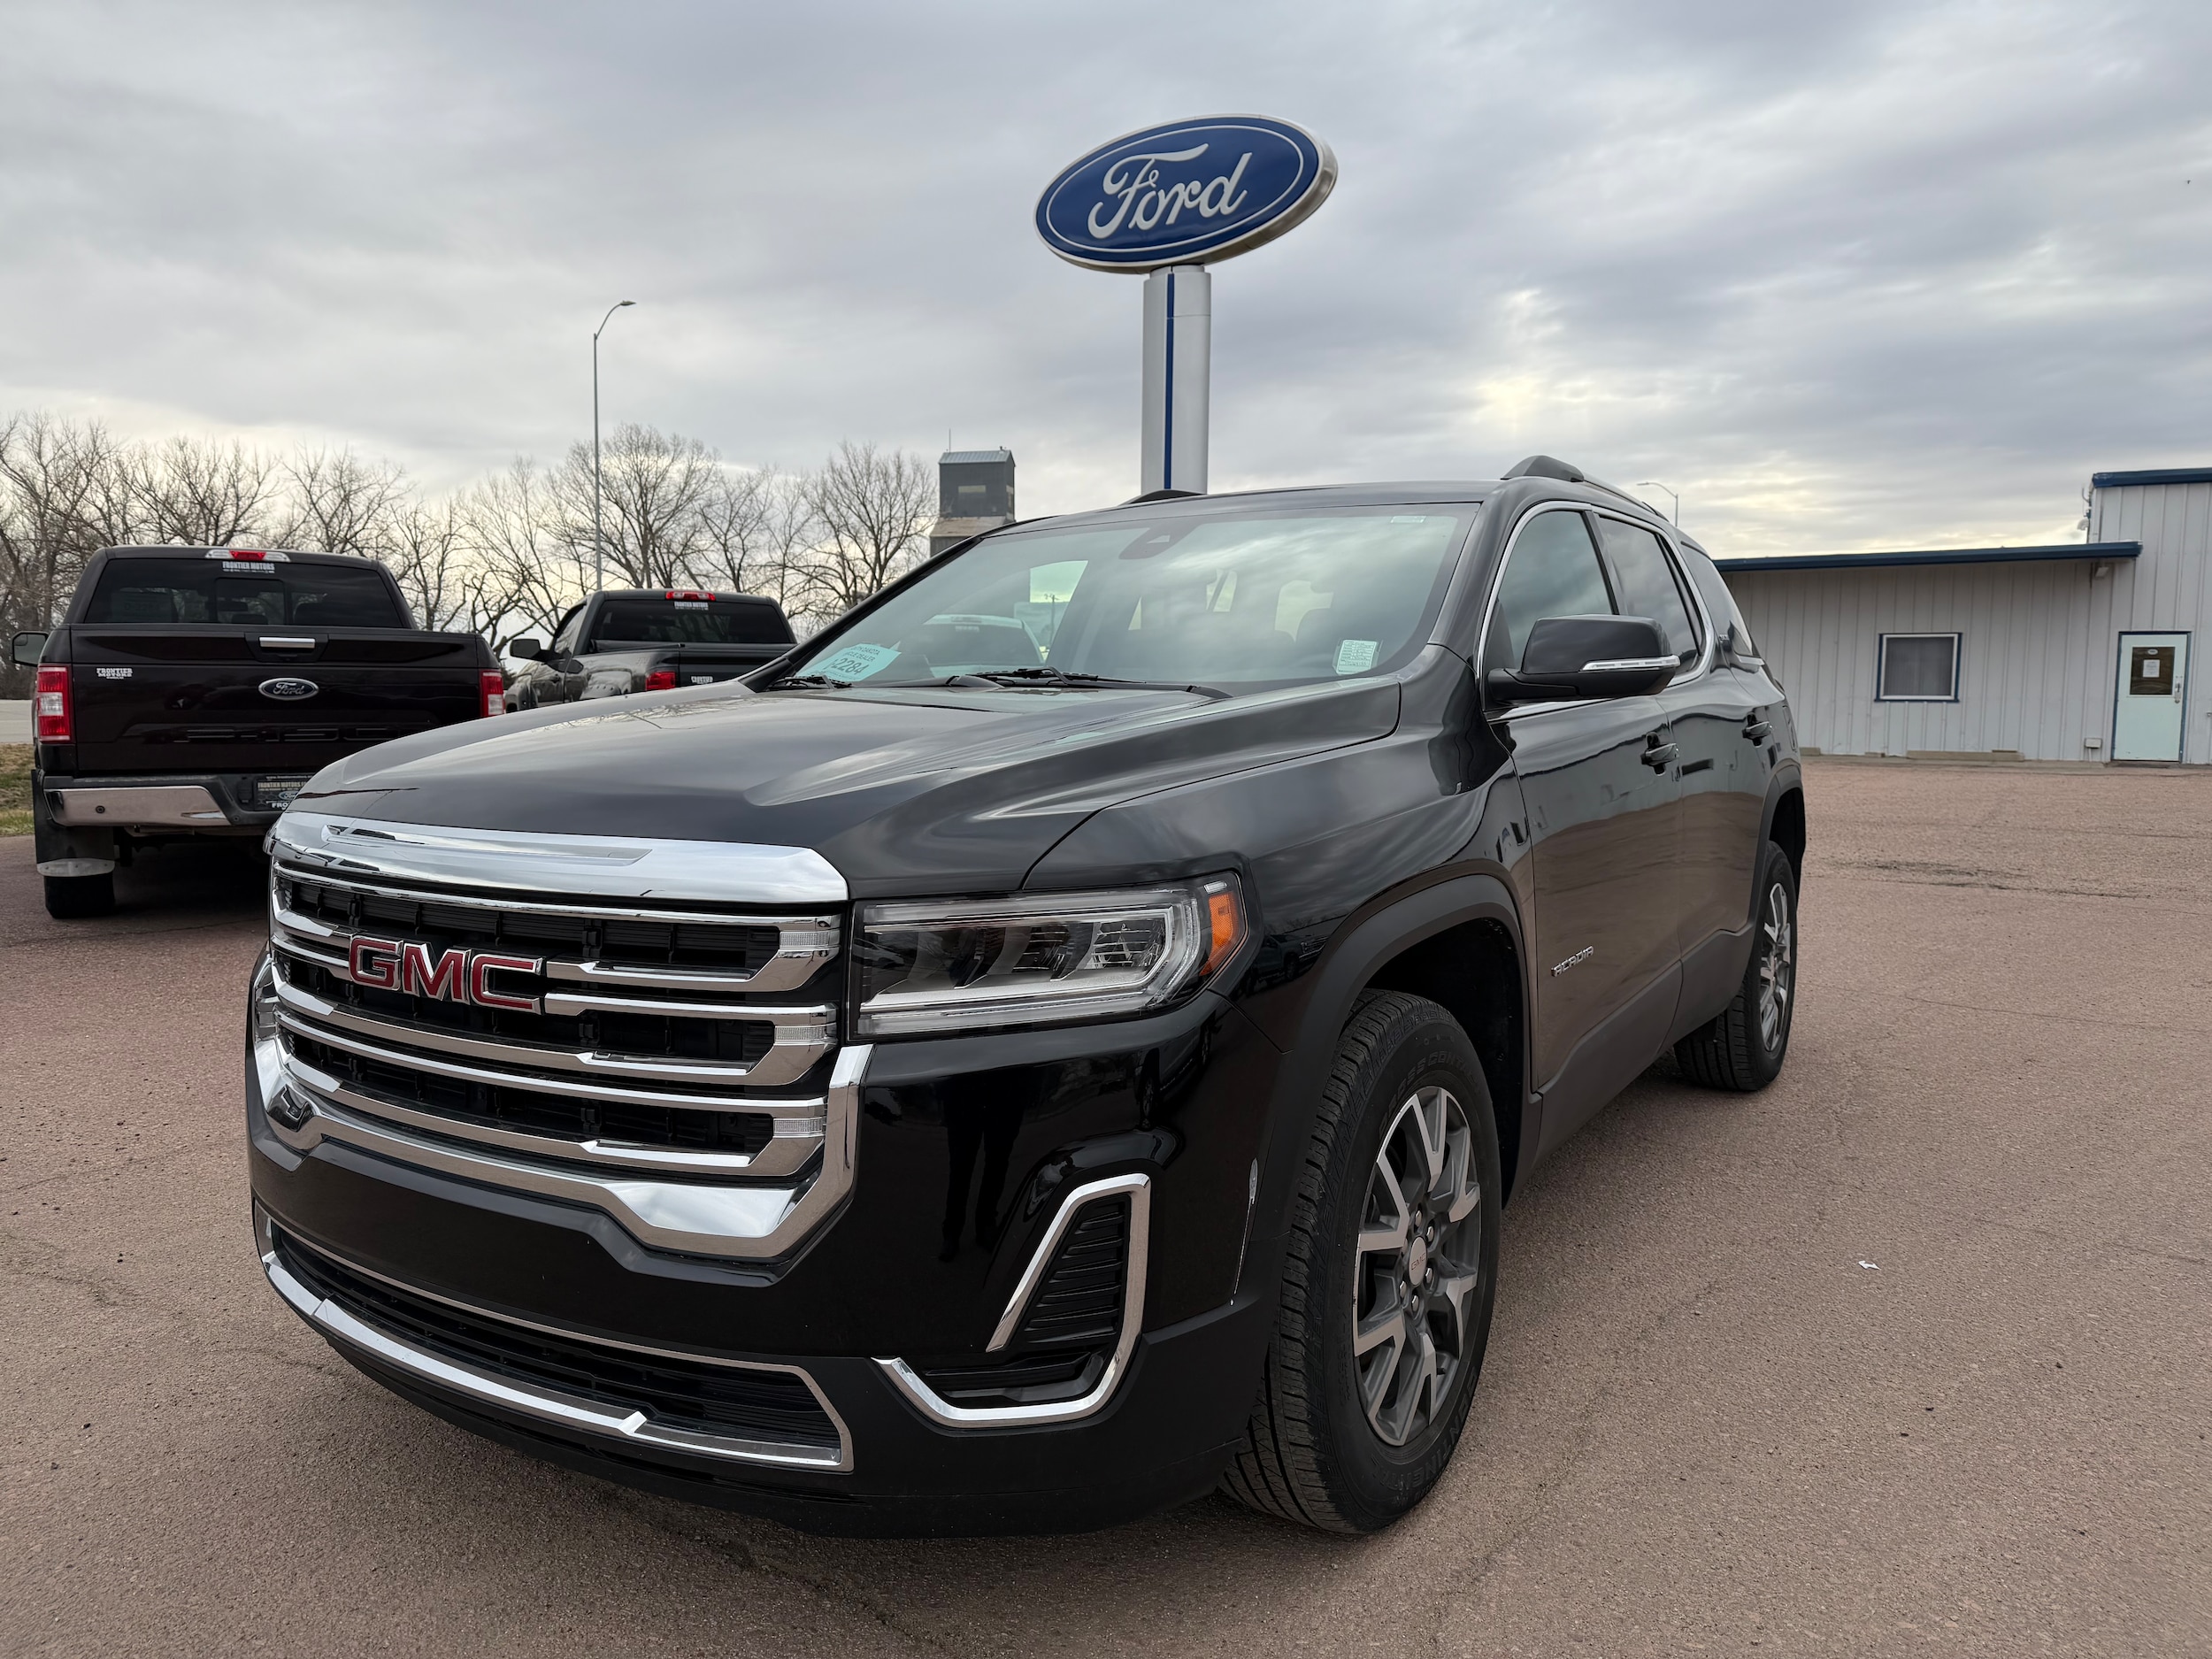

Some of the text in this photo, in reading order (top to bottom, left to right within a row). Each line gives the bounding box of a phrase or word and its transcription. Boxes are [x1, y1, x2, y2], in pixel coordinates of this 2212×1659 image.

[1087, 142, 1252, 239] Ford
[250, 562, 275, 571] MOTORS
[273, 682, 304, 695] Ford
[1551, 945, 1594, 977] ACADIA
[349, 934, 543, 1016] GMC
[1411, 1252, 1426, 1271] GMC
